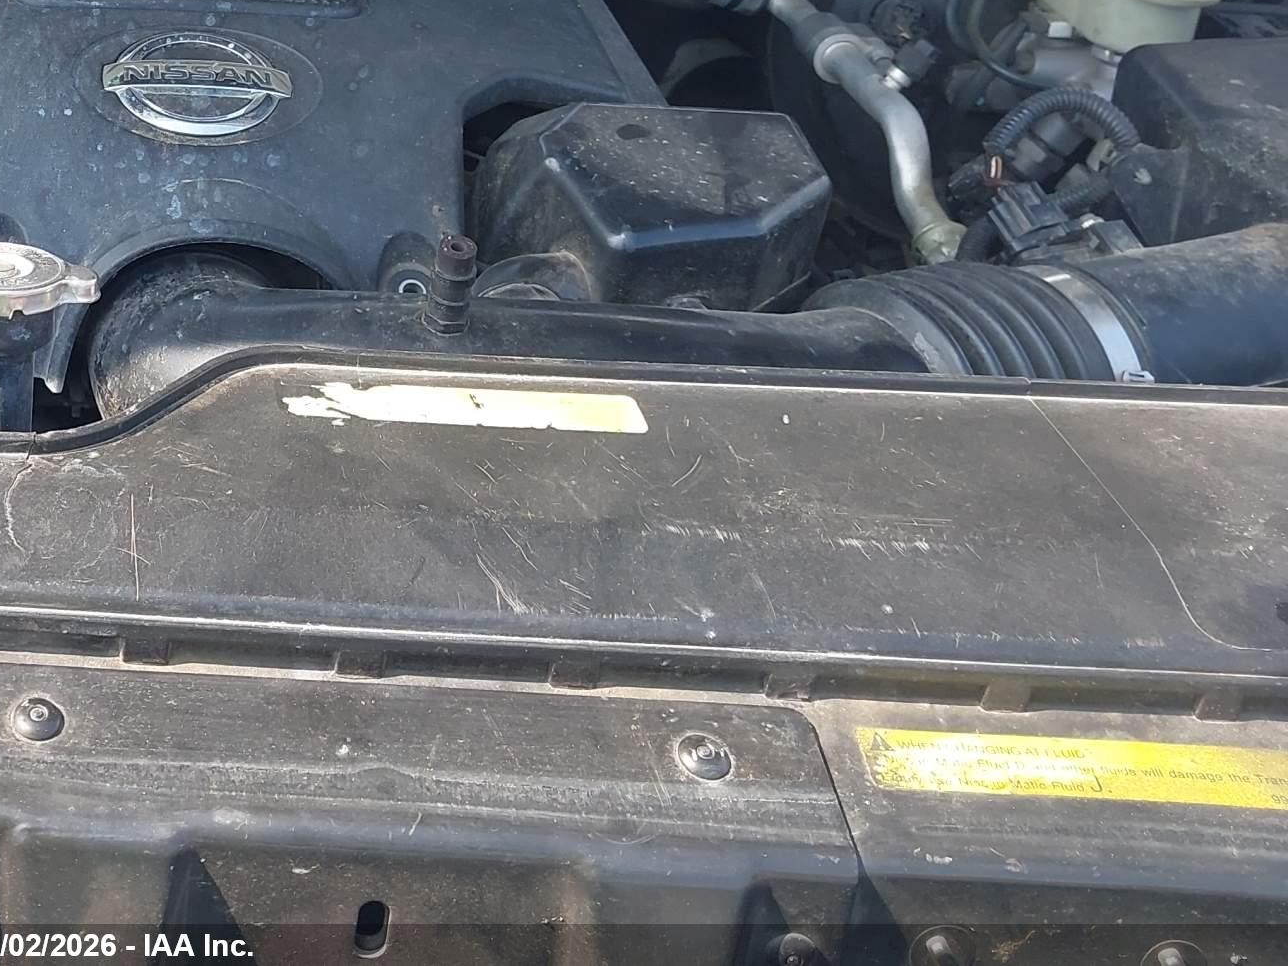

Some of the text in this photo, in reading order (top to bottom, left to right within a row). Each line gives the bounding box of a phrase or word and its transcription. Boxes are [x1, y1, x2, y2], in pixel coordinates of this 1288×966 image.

[123, 63, 271, 85] NISSAN
[1140, 767, 1165, 778] will
[1168, 769, 1224, 783] damage
[1227, 772, 1251, 783] the
[1051, 780, 1085, 792] Fluid
